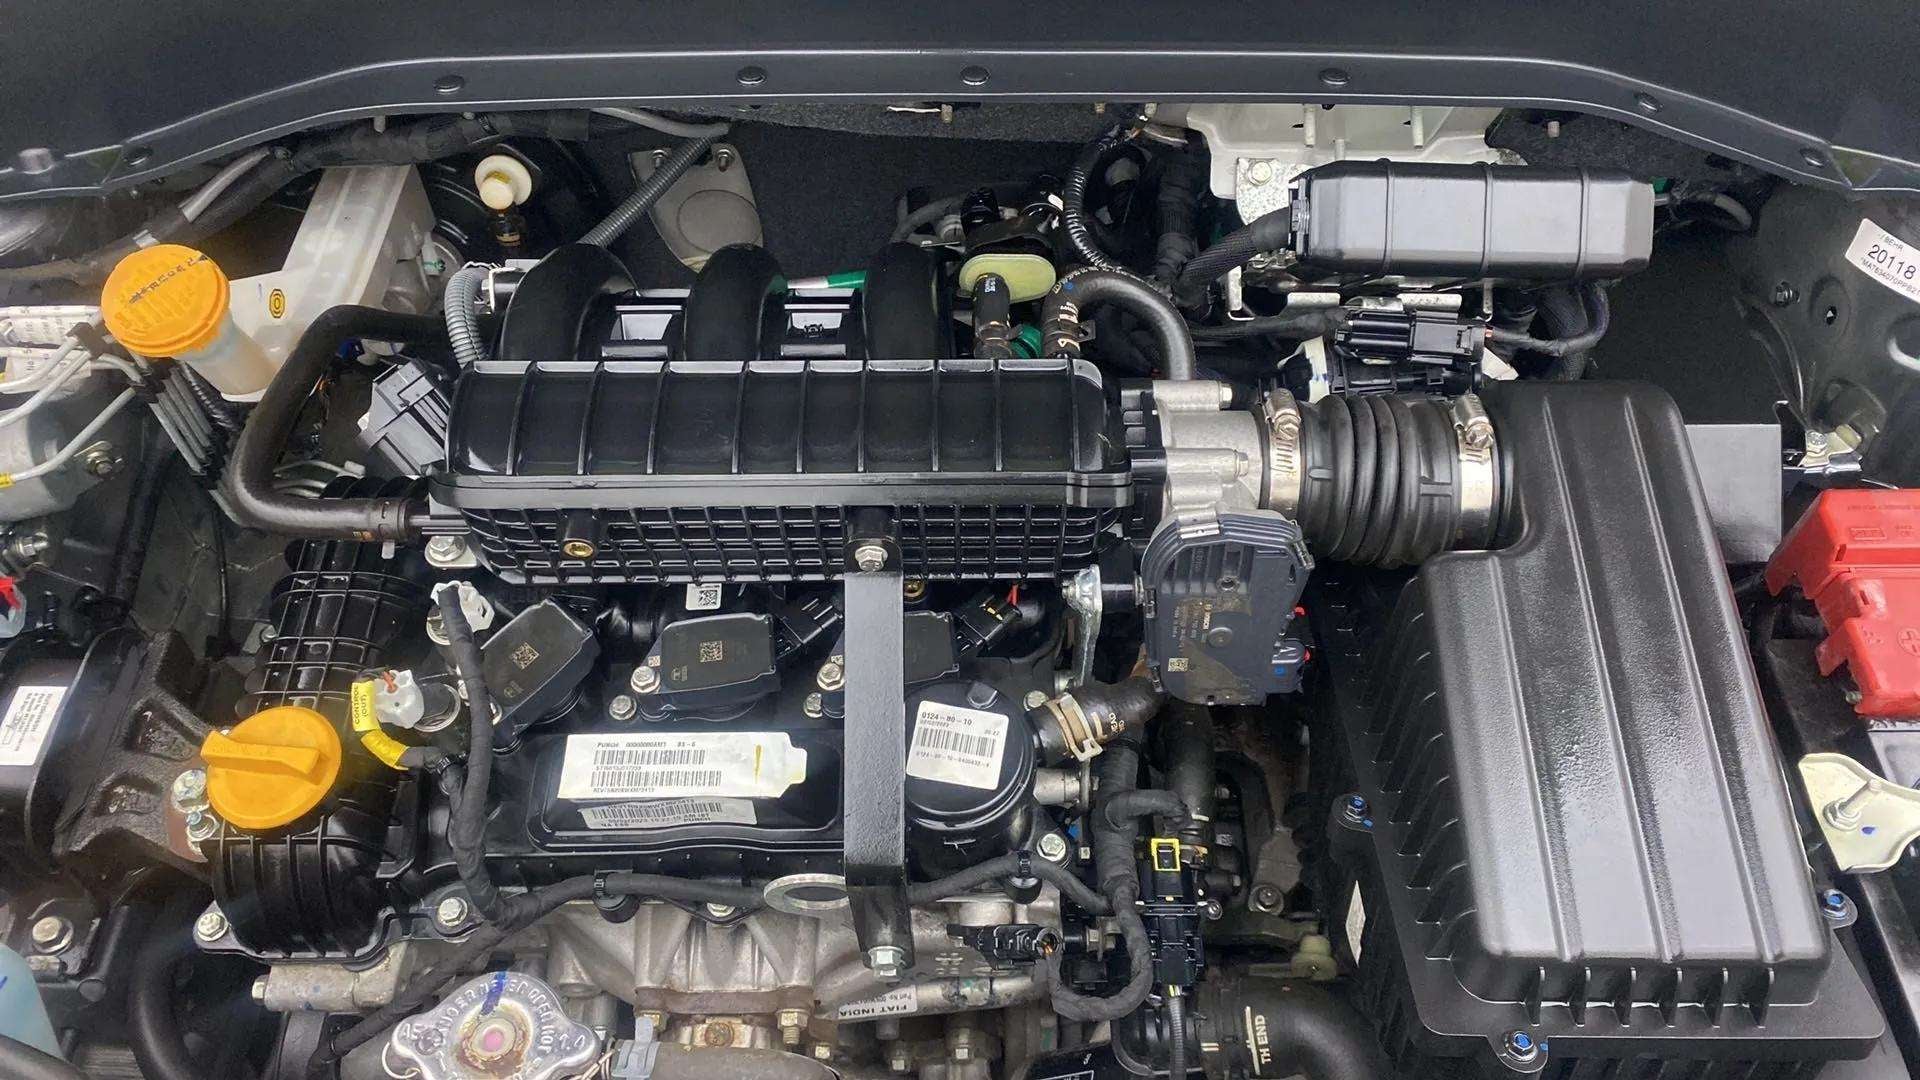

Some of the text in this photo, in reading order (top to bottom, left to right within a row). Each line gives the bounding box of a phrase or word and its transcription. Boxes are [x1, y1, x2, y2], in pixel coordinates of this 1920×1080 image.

[1868, 244, 1917, 280] 20118
[360, 694, 369, 718] (OUT)
[839, 1004, 908, 1017] FIAT INDIA
[1255, 1014, 1268, 1045] END
